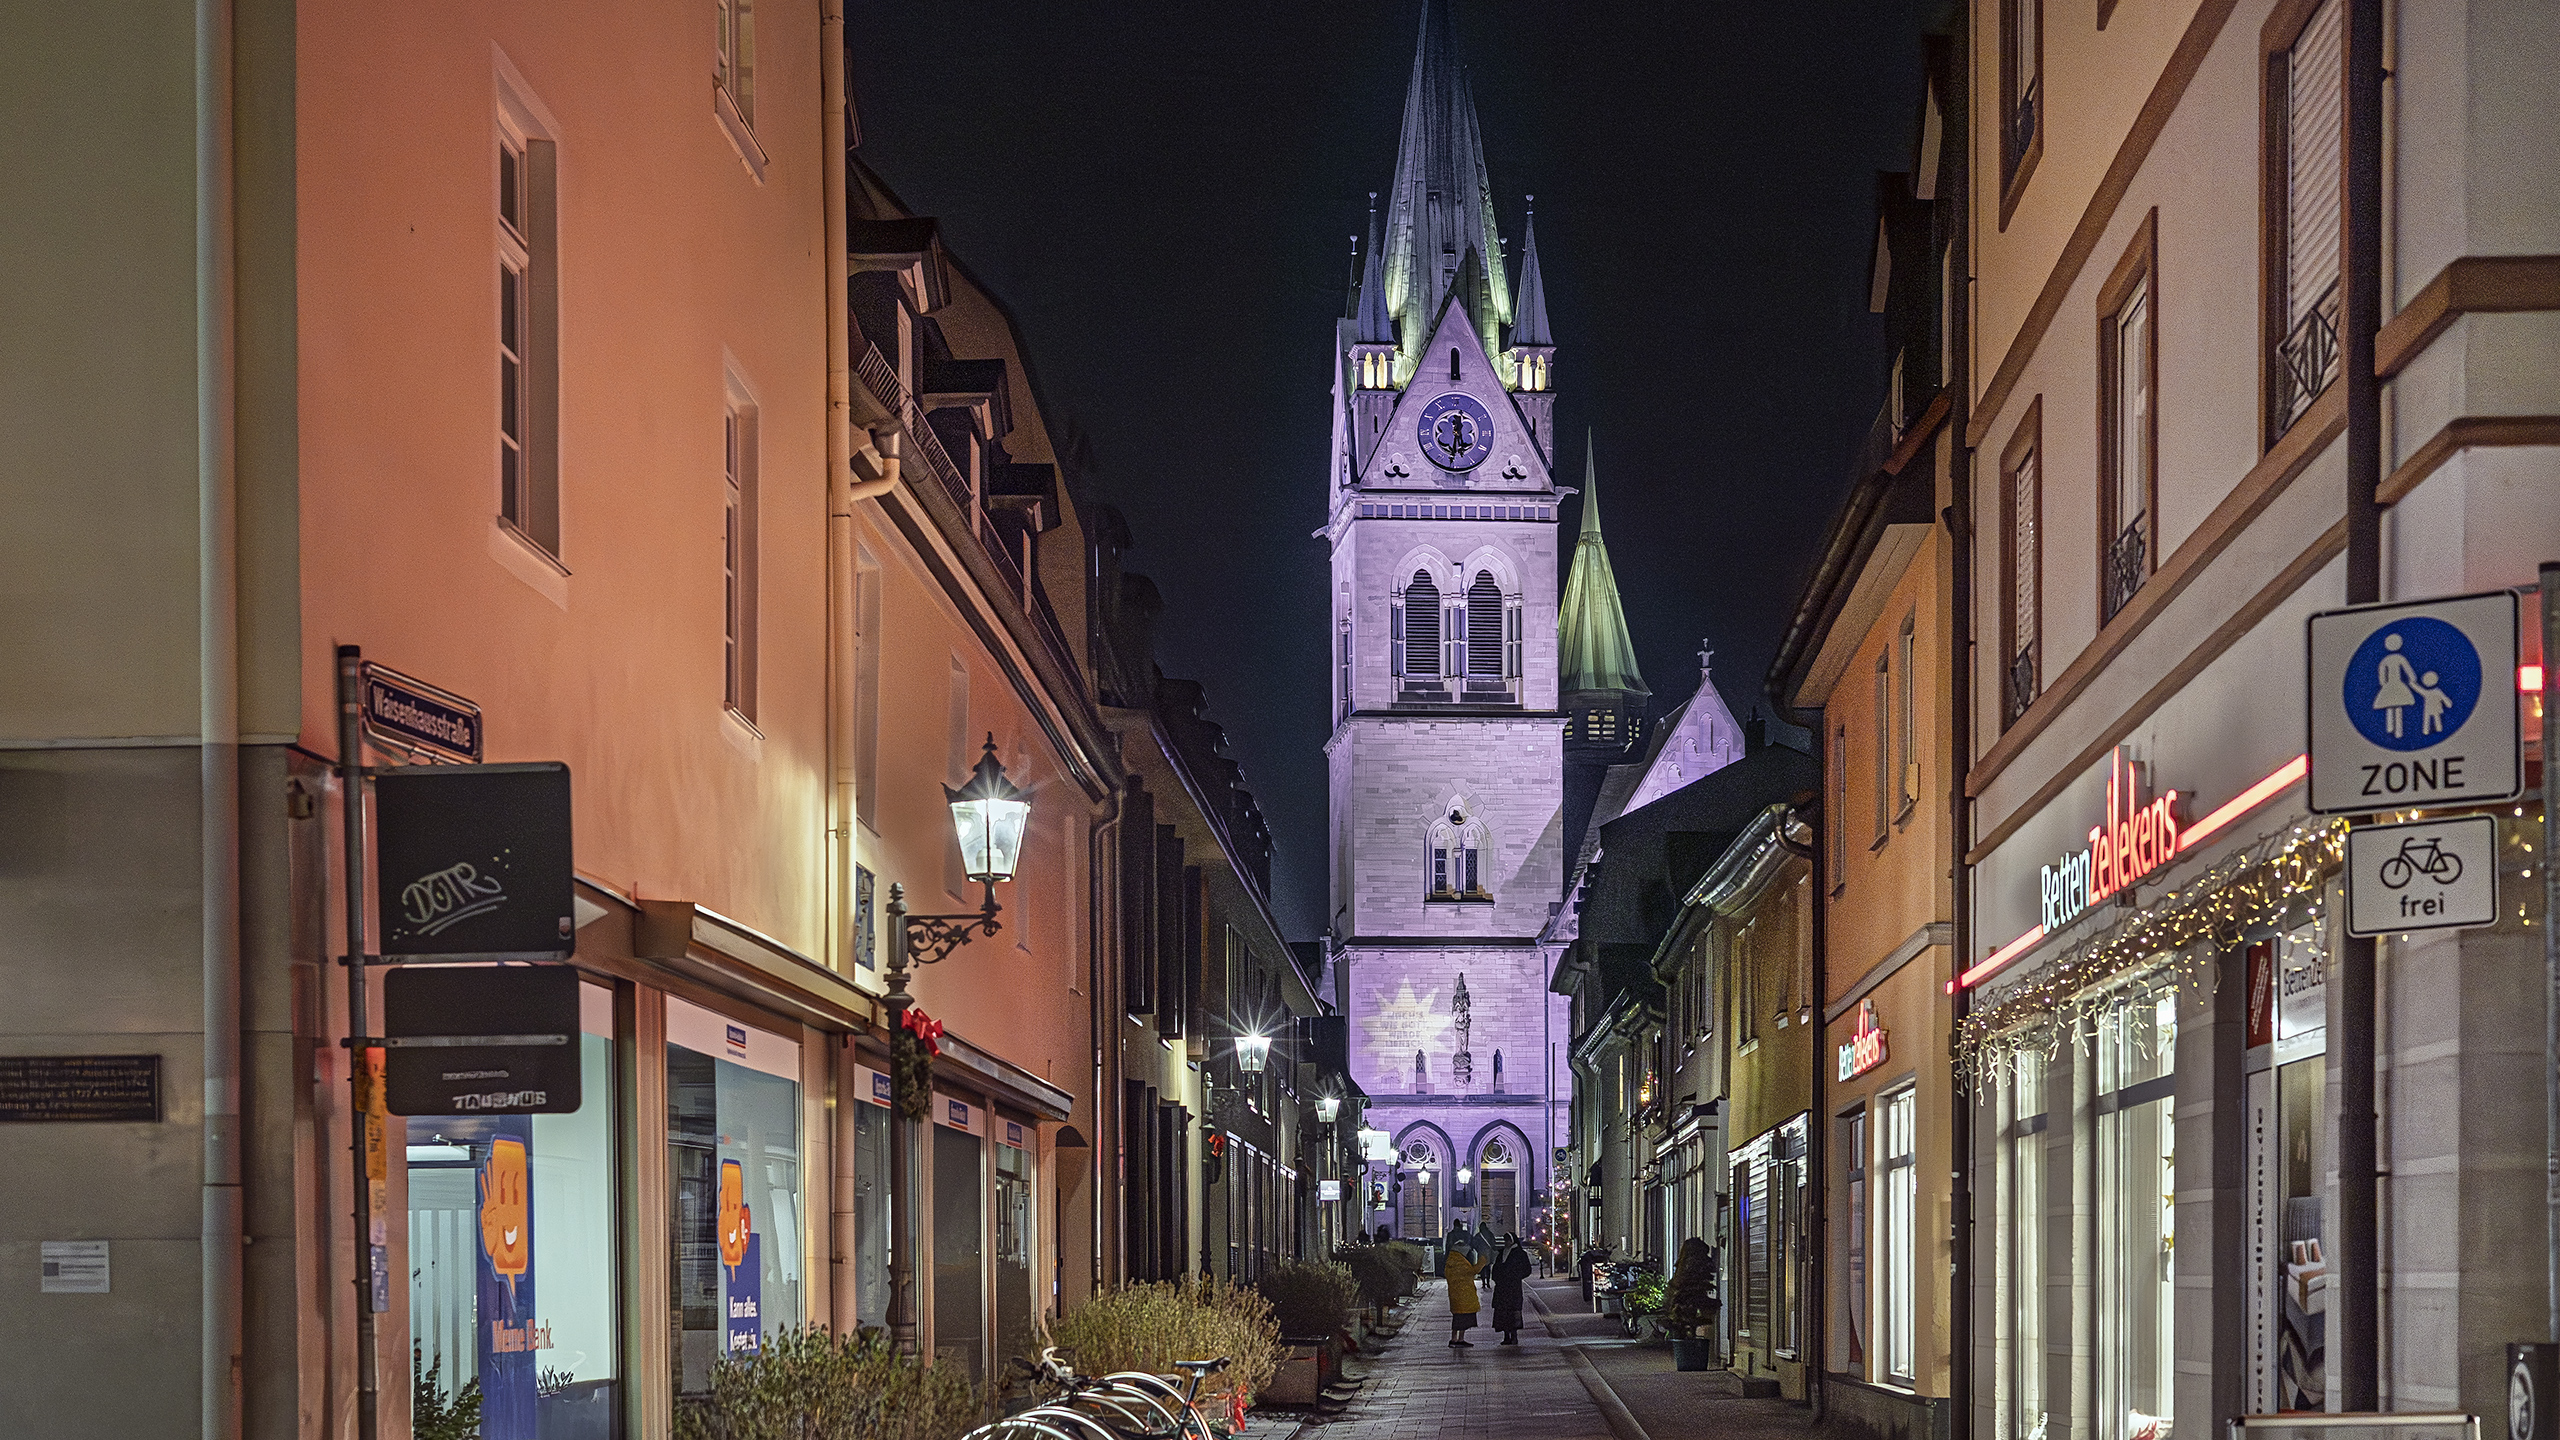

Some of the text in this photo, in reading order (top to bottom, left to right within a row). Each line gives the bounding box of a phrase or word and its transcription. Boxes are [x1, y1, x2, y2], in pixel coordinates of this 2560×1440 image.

[372, 685, 471, 749] Waisenhausstraße
[2360, 756, 2466, 797] ZONE
[2399, 892, 2445, 918] frei
[492, 1318, 526, 1353] Meine
